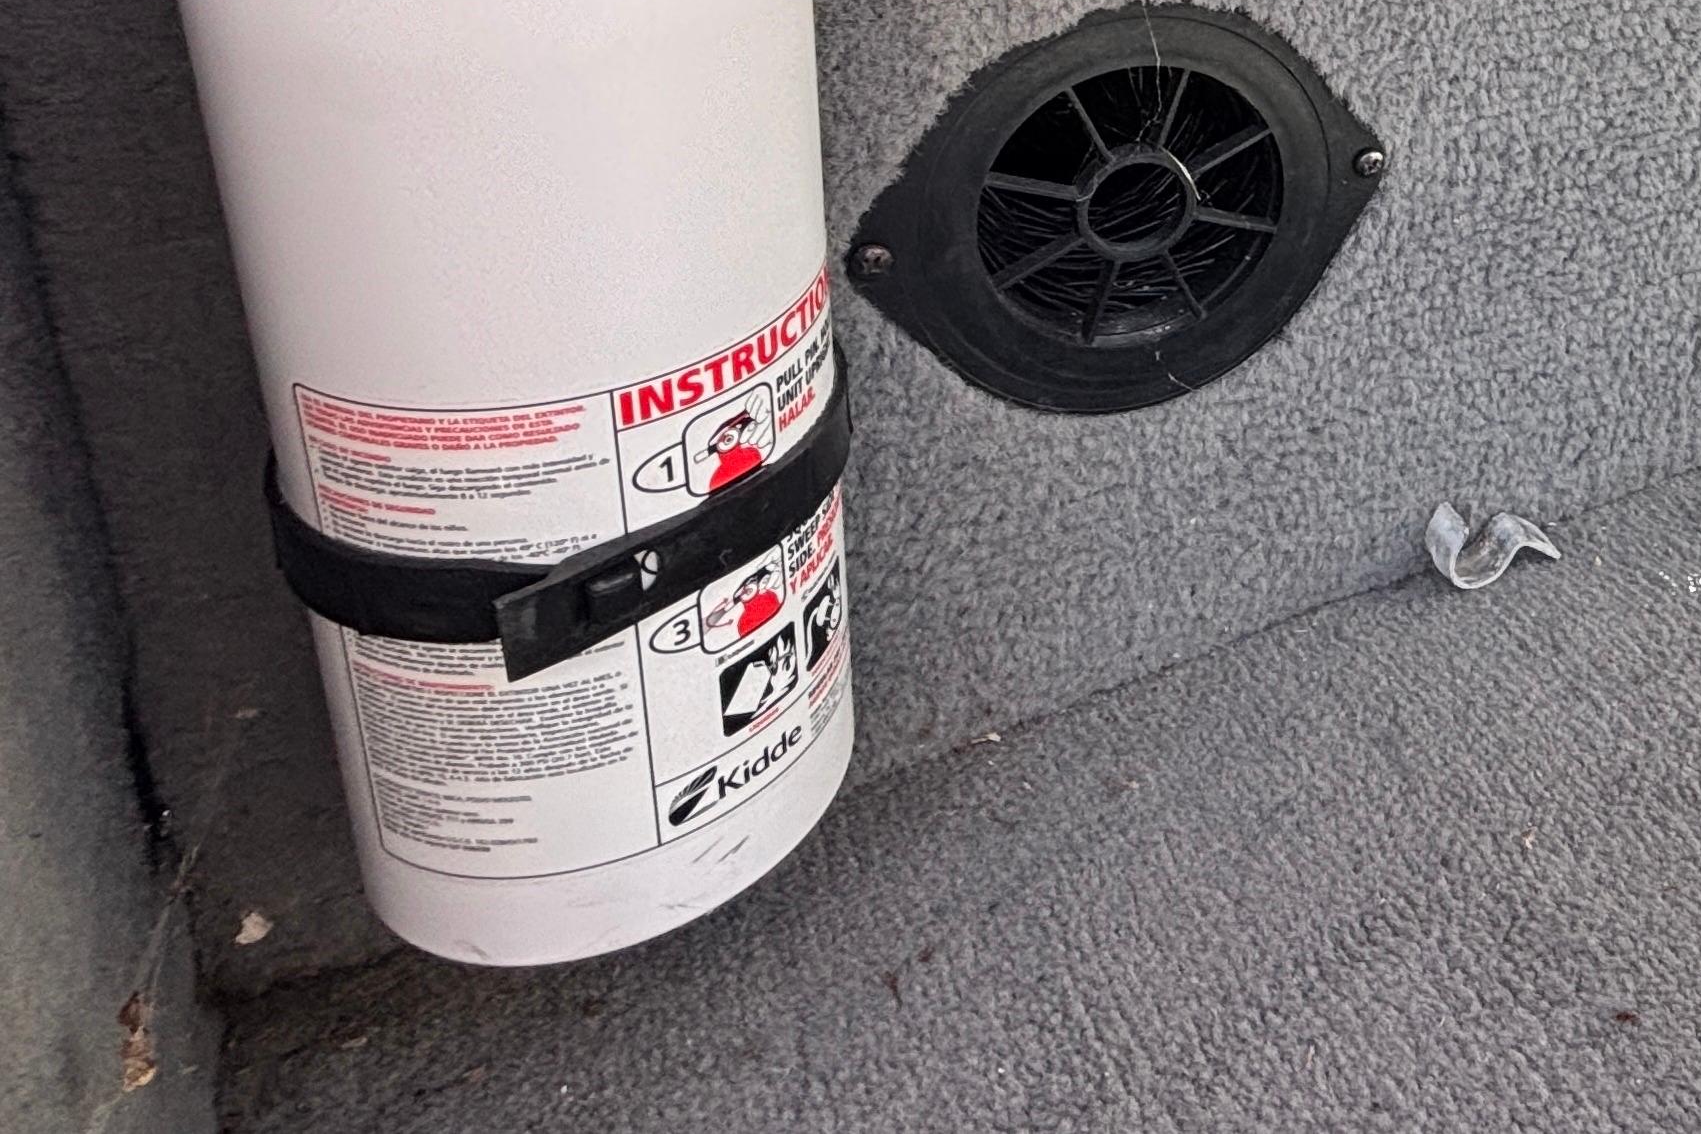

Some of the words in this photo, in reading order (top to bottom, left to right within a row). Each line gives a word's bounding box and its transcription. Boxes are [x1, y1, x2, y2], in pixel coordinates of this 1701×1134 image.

[776, 357, 803, 393] PULL
[777, 376, 803, 412] UNIT
[659, 455, 674, 483] 1
[787, 513, 820, 560] SWEEP
[789, 576, 797, 595] Y
[673, 619, 691, 646] 3
[717, 724, 802, 800] Kidde
